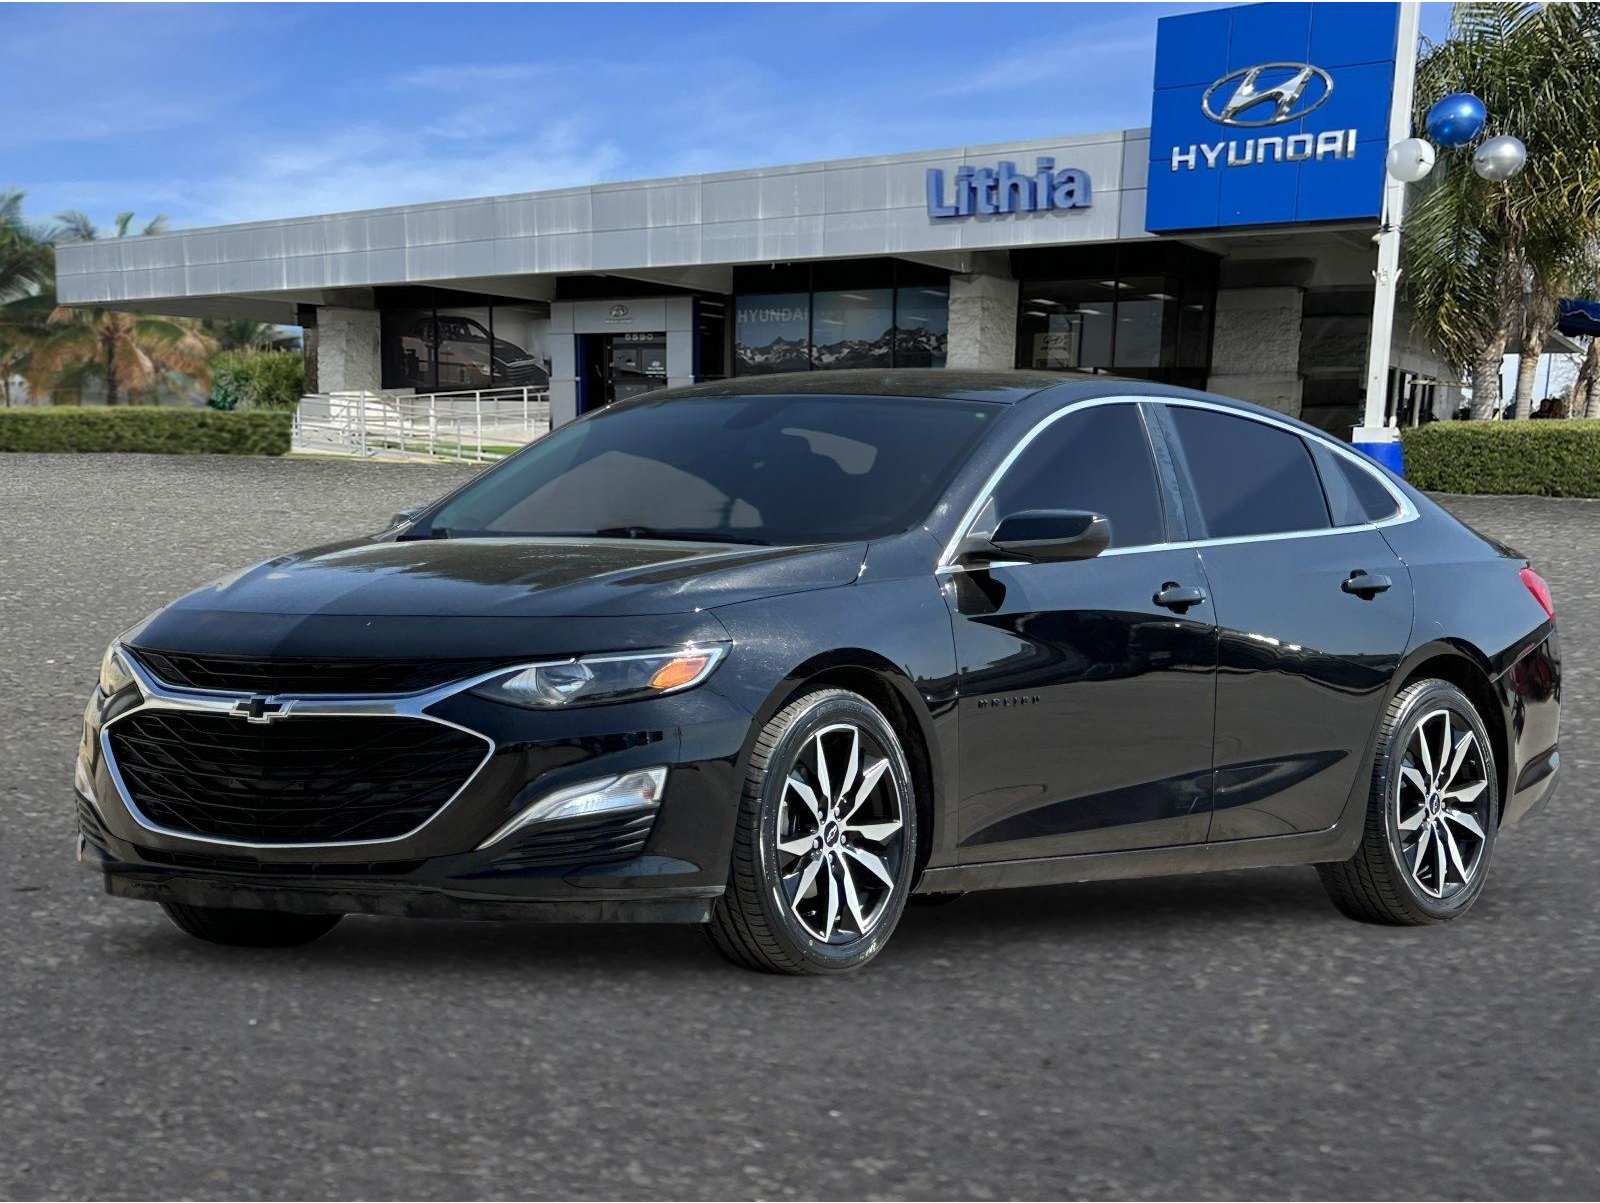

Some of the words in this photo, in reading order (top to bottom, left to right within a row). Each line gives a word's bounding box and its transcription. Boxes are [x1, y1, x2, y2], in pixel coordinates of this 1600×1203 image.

[1171, 129, 1357, 171] HYUNDAI
[926, 157, 1092, 217] Lithia
[737, 307, 809, 322] HYUNDAI
